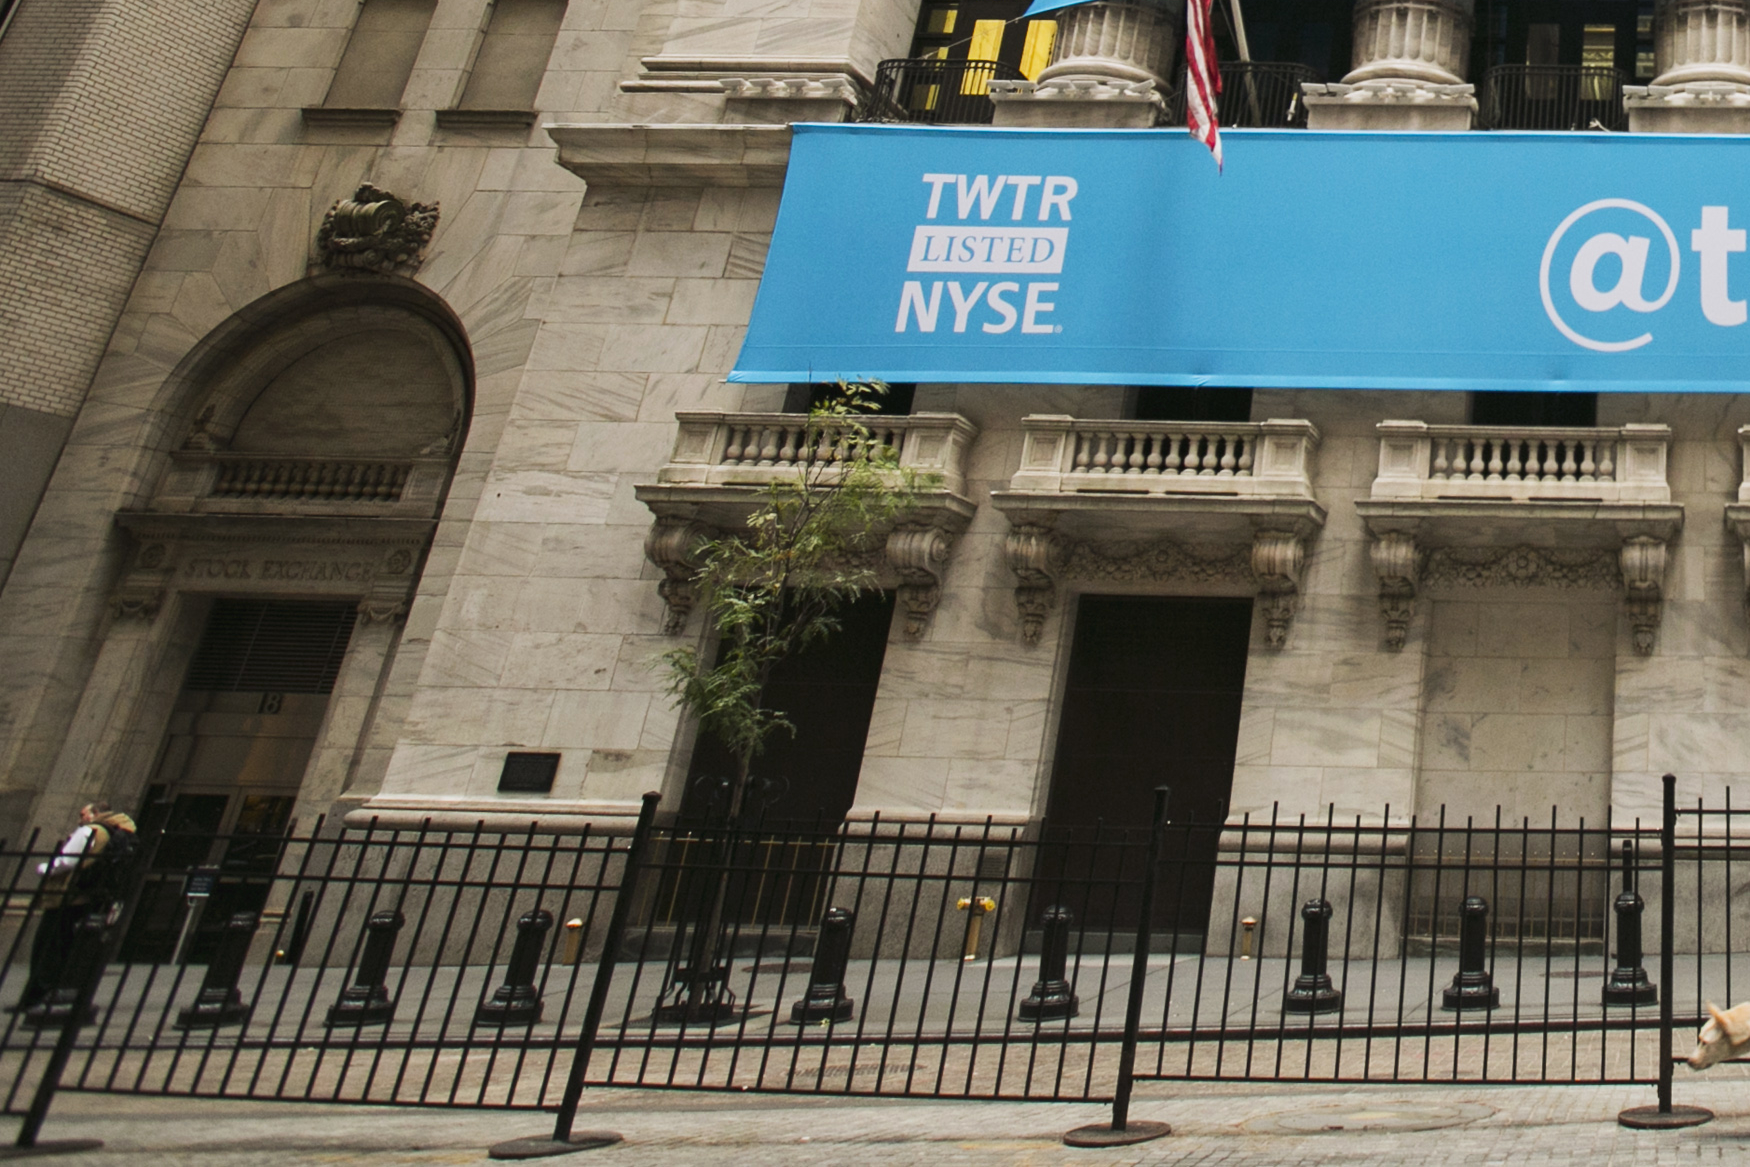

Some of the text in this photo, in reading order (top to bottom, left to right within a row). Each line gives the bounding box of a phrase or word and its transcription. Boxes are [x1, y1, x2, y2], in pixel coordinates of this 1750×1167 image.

[922, 173, 1079, 221] TWTR
[919, 235, 1055, 264] LISTED
[185, 558, 374, 583] STOCK EXCHANGE
[256, 692, 283, 715] 18
